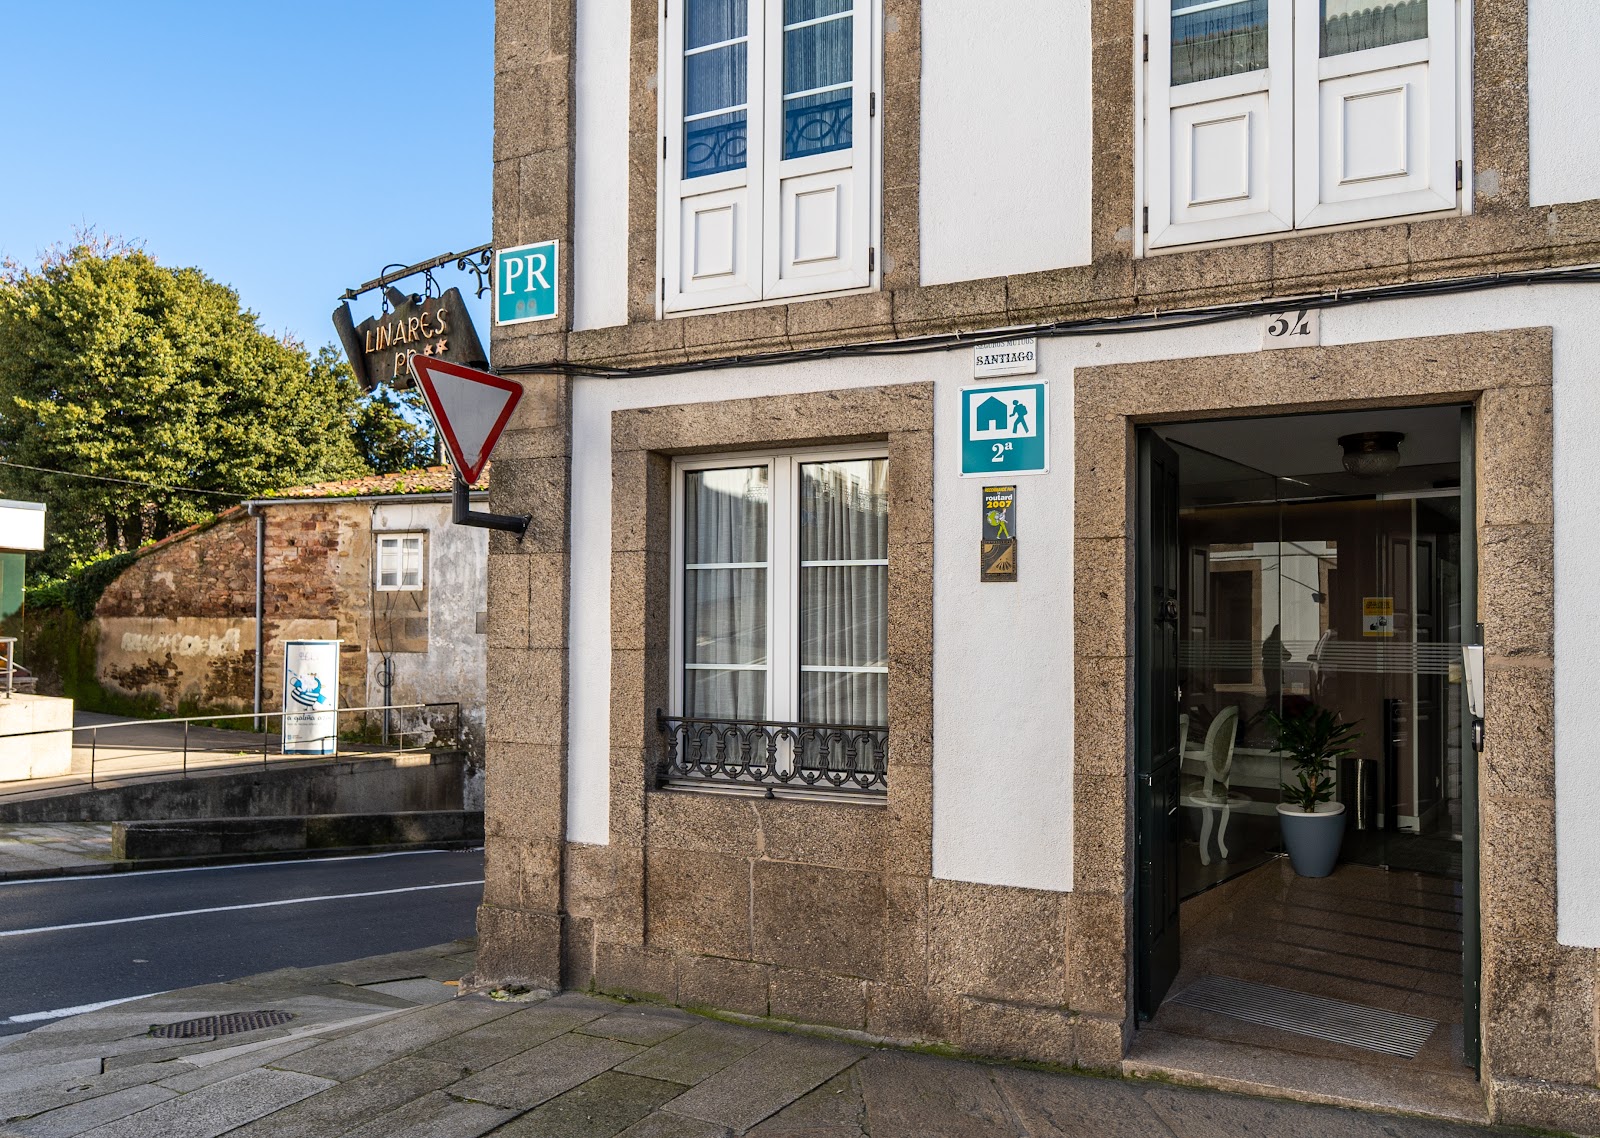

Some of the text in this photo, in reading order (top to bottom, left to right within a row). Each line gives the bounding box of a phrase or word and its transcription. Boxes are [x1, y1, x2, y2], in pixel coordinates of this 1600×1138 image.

[503, 253, 551, 295] PR
[365, 308, 449, 354] LINARES
[1268, 309, 1311, 337] 34
[985, 494, 1013, 502] routard
[986, 500, 1012, 509] 2007
